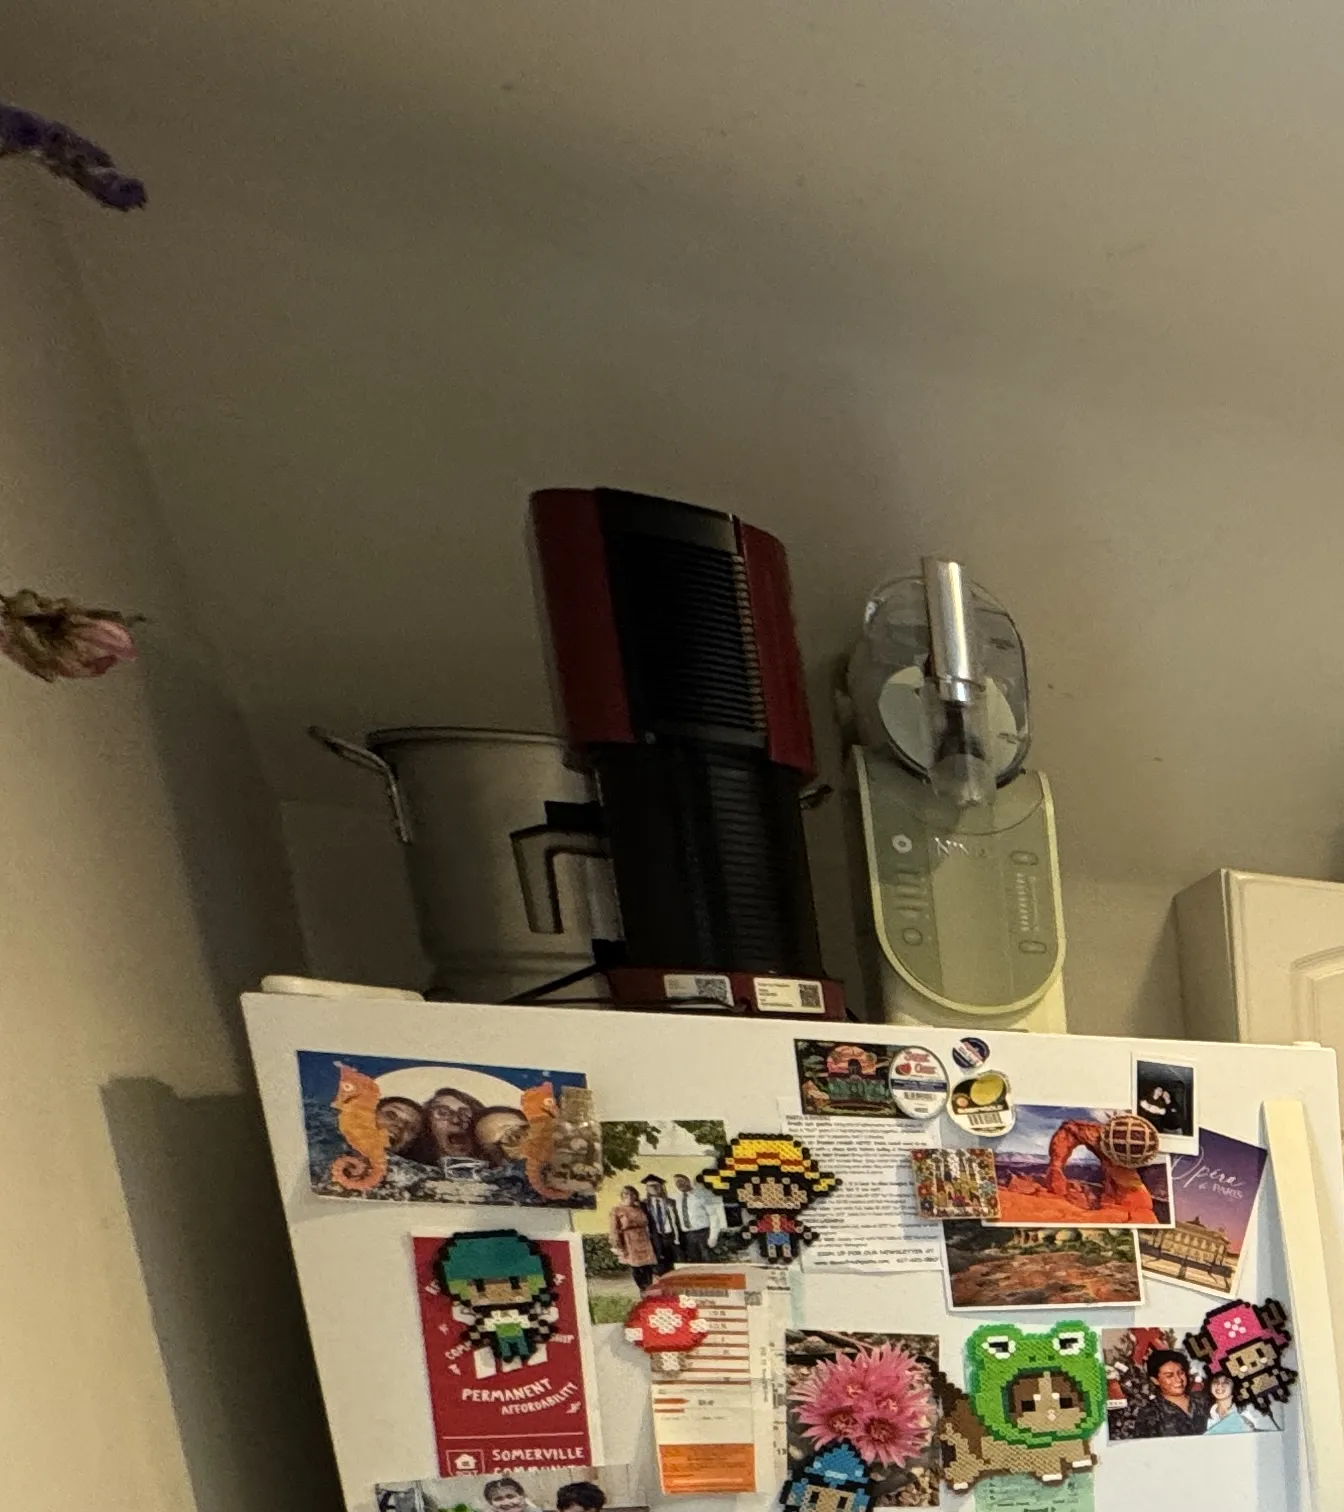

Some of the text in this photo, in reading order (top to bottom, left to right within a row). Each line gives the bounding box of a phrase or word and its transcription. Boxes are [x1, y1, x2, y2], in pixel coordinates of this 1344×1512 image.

[461, 1378, 552, 1402] PERMANENT
[501, 1382, 579, 1416] AFFORDABILITY
[492, 1447, 585, 1461] SOMERVILLE
